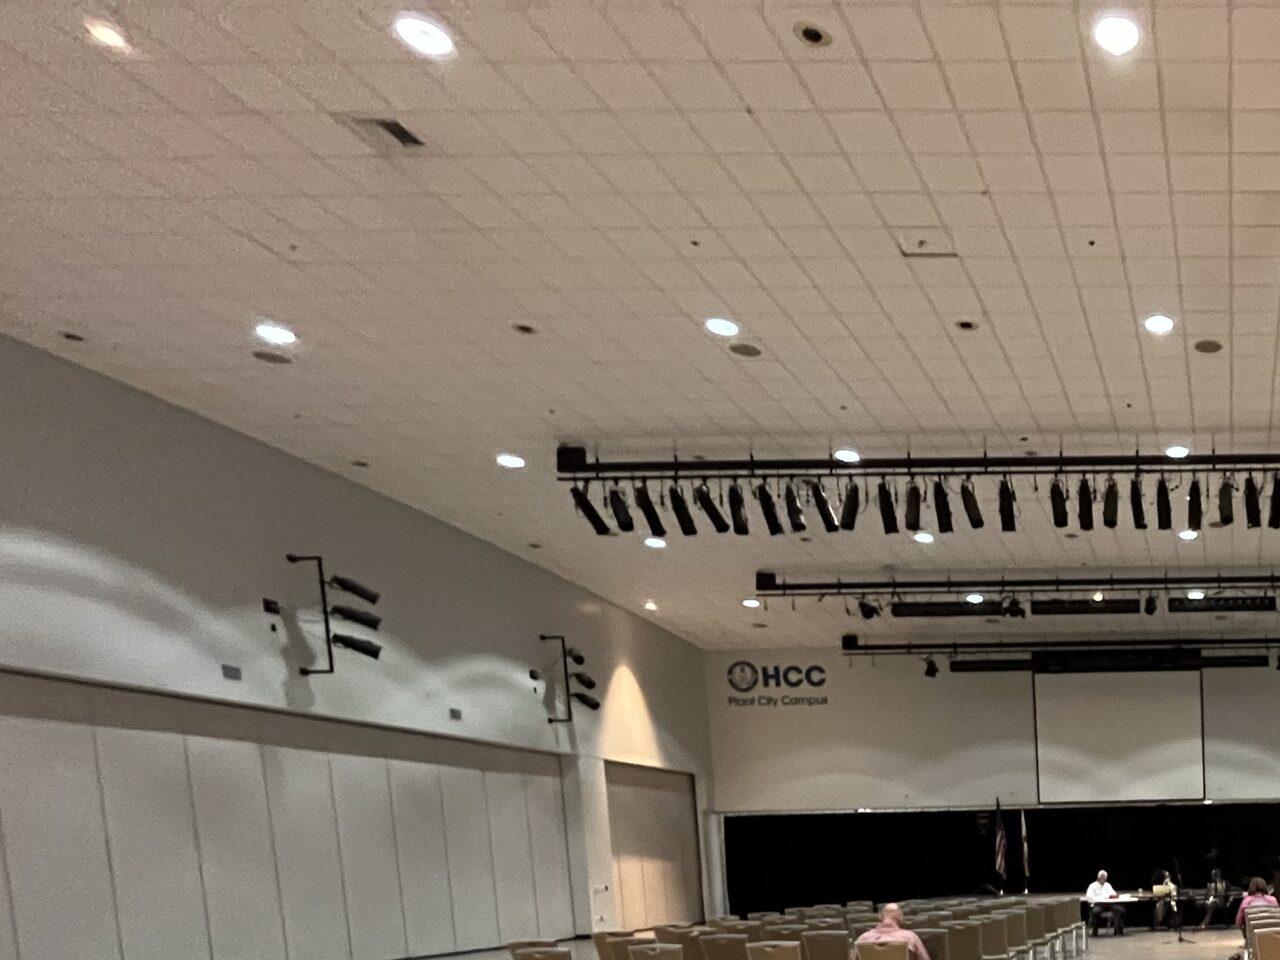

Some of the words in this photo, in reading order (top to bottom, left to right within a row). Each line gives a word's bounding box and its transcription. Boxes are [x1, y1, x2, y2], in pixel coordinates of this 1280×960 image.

[762, 665, 826, 687] HCC
[728, 696, 755, 706] Plant
[758, 696, 778, 707] City
[782, 696, 828, 706] Campus
